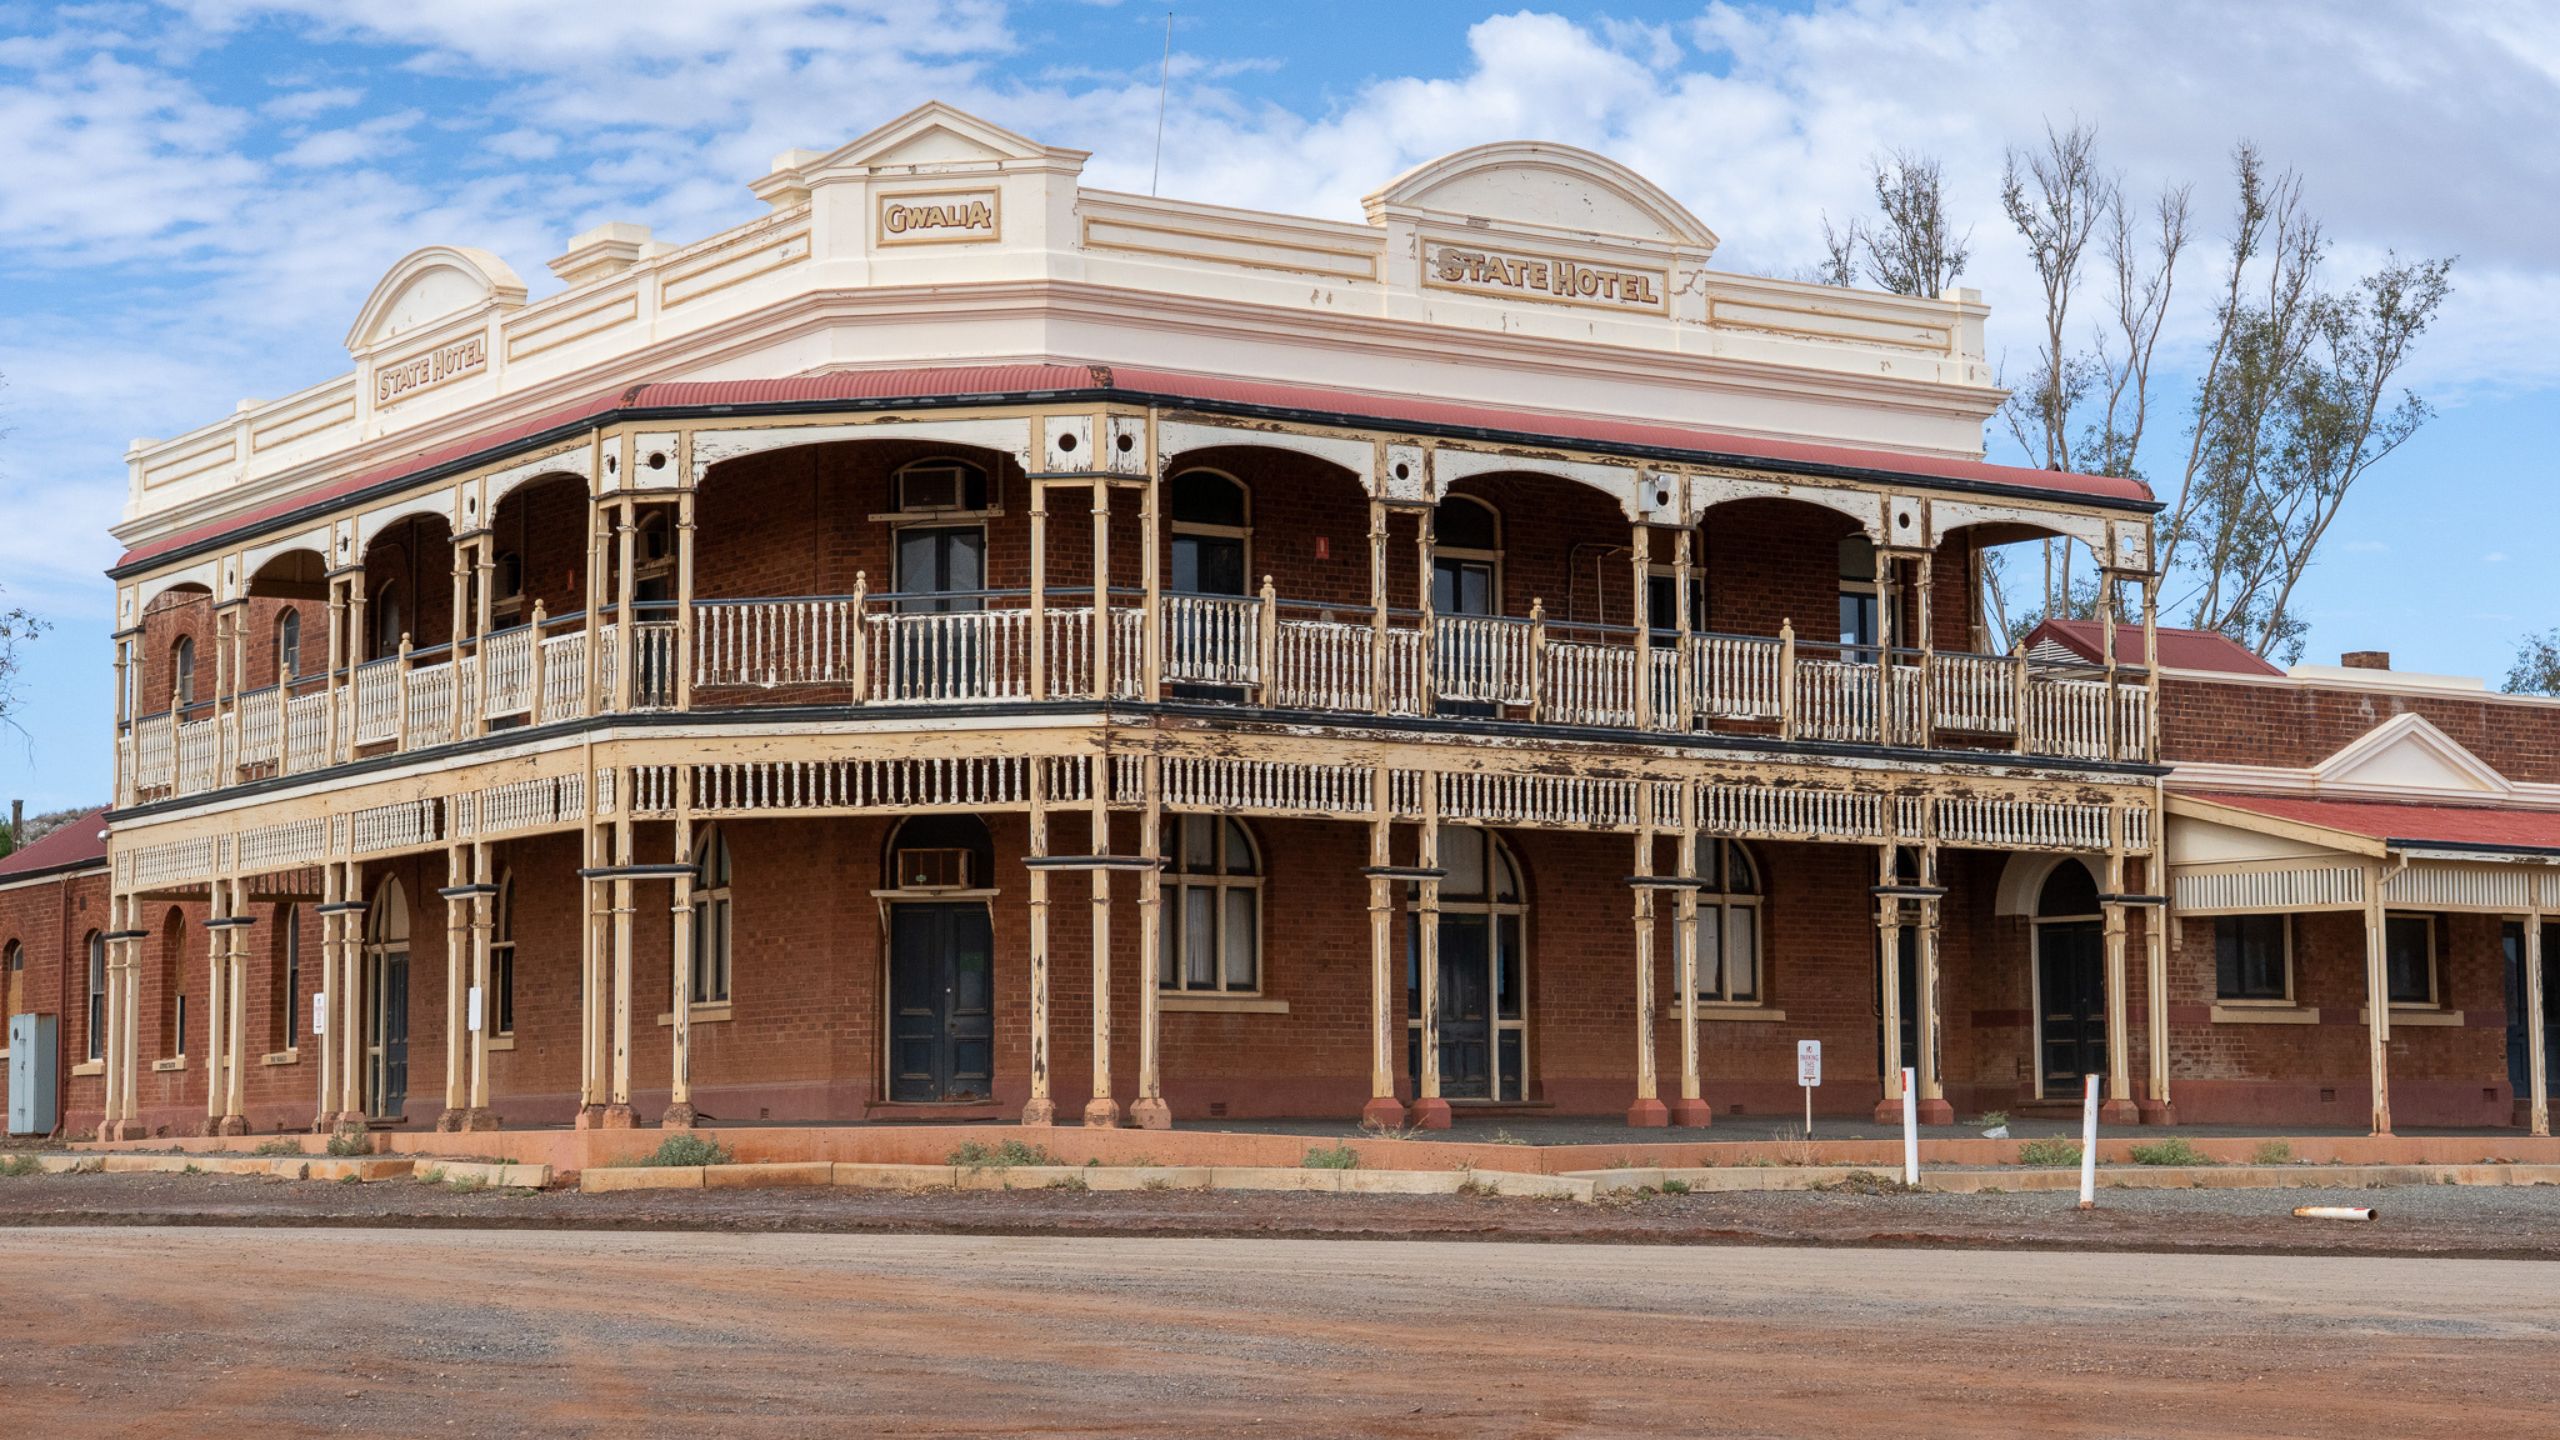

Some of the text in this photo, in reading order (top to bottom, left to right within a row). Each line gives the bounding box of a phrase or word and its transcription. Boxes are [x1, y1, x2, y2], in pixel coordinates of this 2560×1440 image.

[885, 201, 991, 233] GWALIA
[1438, 249, 1658, 304] STATE HOTEL
[380, 339, 485, 400] STATE HOTEL
